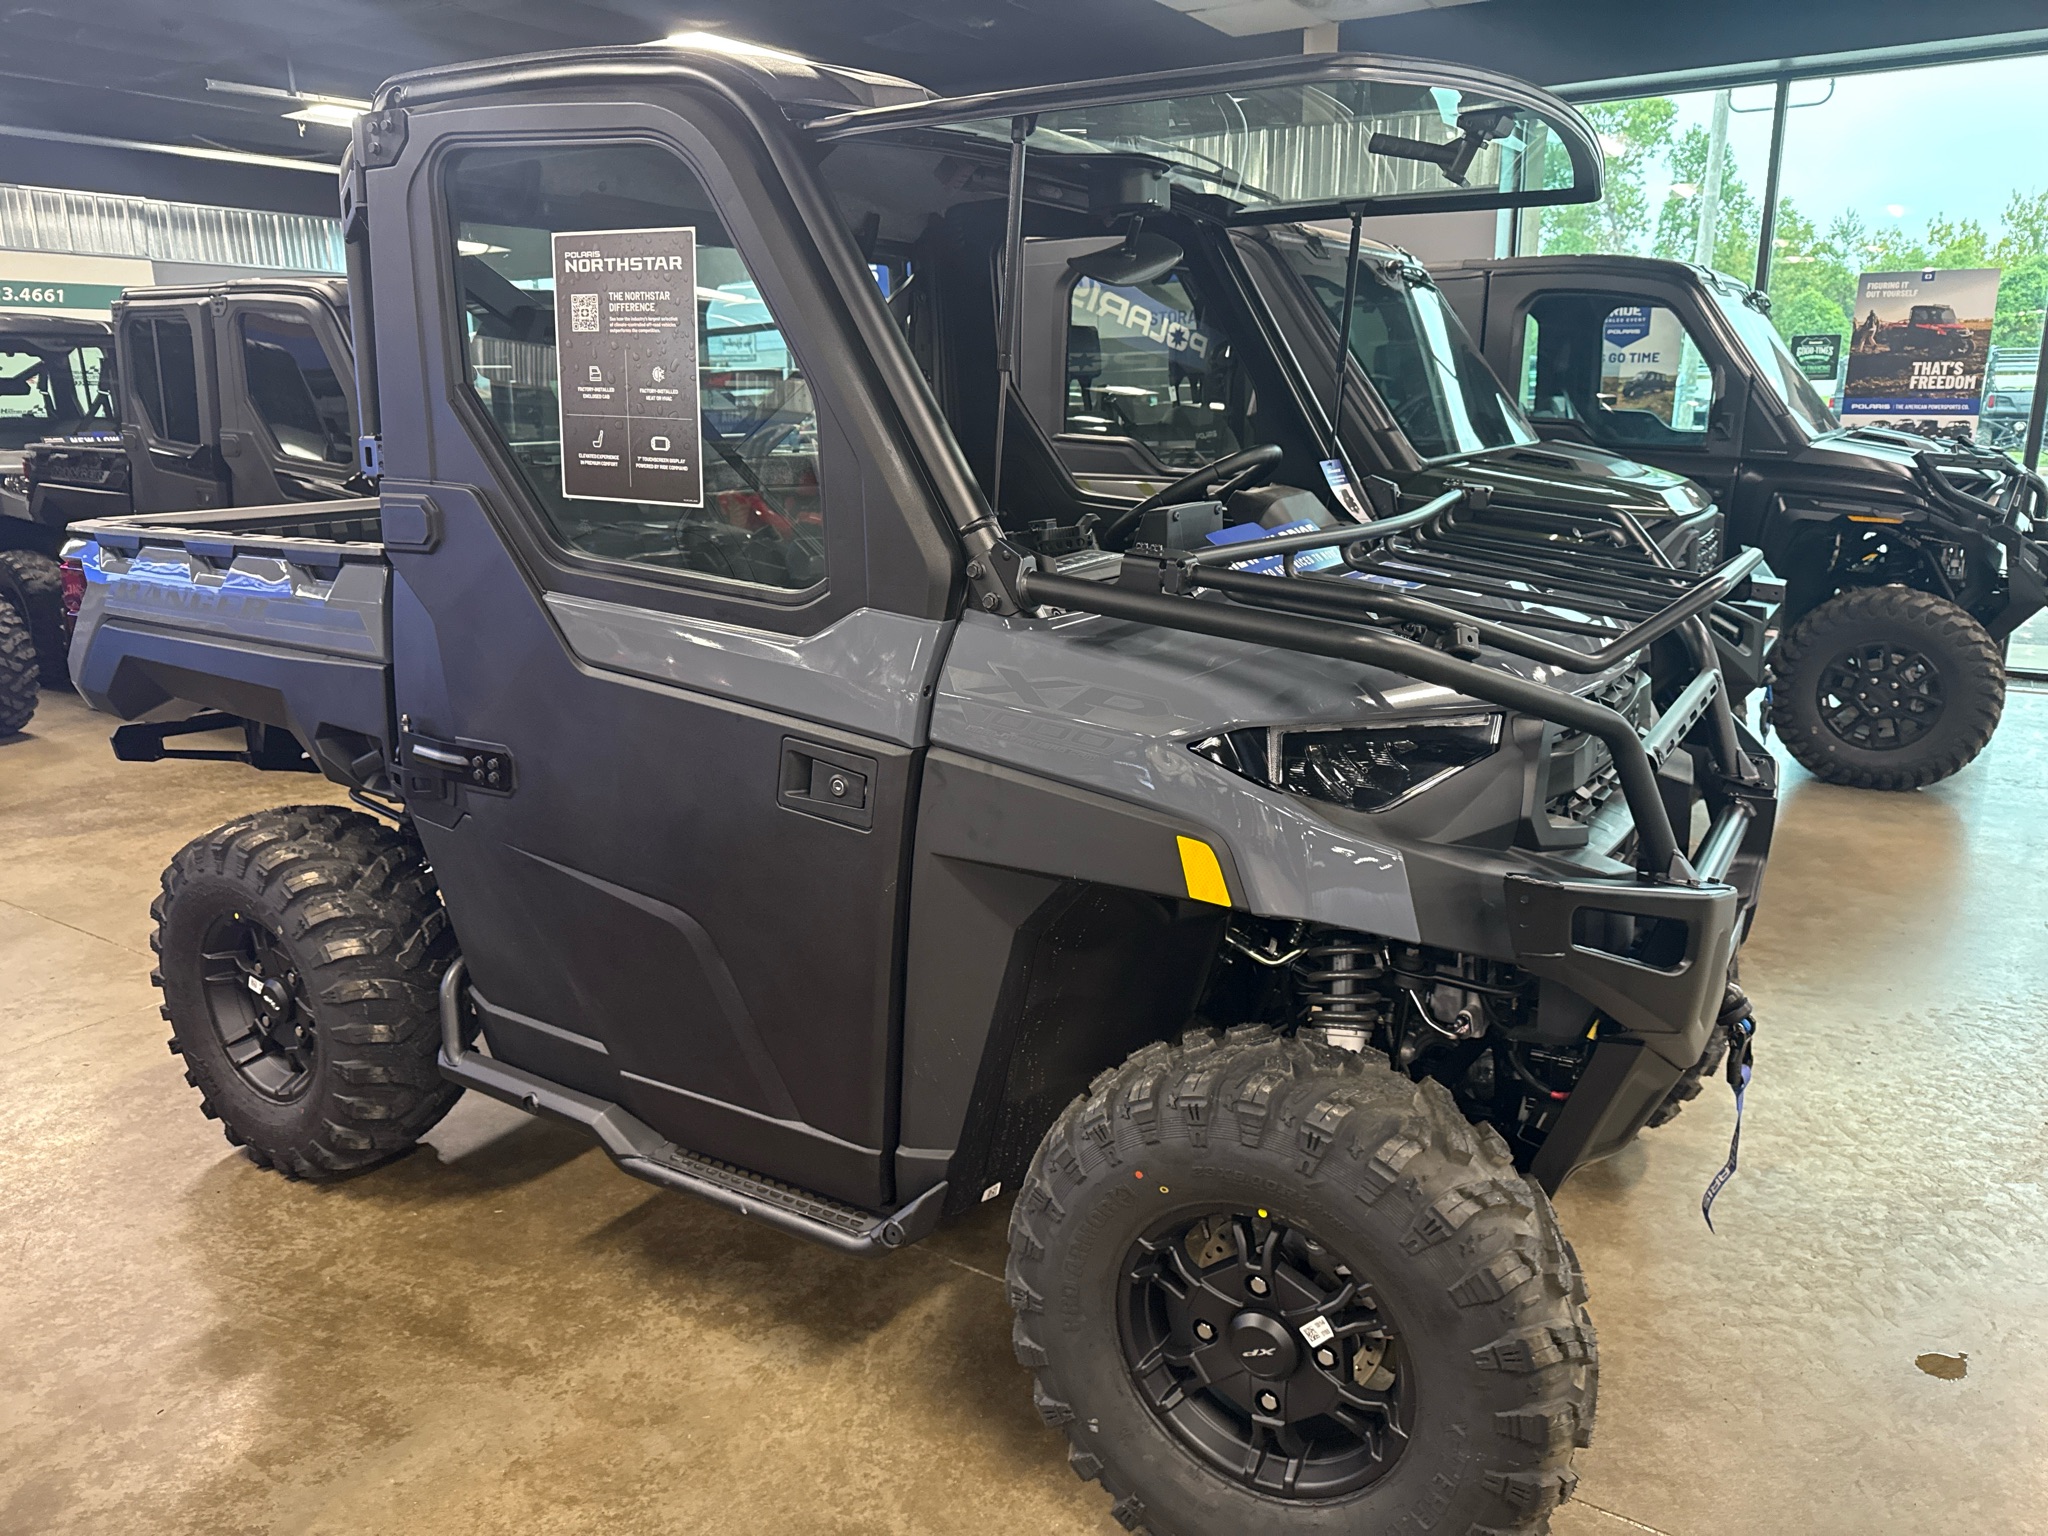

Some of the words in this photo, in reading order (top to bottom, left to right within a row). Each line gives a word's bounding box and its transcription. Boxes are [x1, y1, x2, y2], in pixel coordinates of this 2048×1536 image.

[565, 250, 601, 259] POLARIS
[564, 256, 683, 273] NORTHSTAR
[1867, 282, 1900, 290] FIGURING
[1901, 281, 1910, 289] IT
[0, 287, 64, 303] 3.4661
[608, 291, 623, 301] THE
[625, 290, 671, 301] NORTHSTAR
[1866, 290, 1881, 298] OUT
[1882, 289, 1919, 298] YOURSELF
[609, 302, 655, 312] DIFFERENCE
[1608, 353, 1626, 363] GO
[1629, 352, 1660, 363] TIME
[1912, 361, 1965, 376] THAT'S
[1909, 375, 1977, 390] FREEDOM
[117, 581, 270, 619] RANGER
[962, 665, 1173, 718] XP
